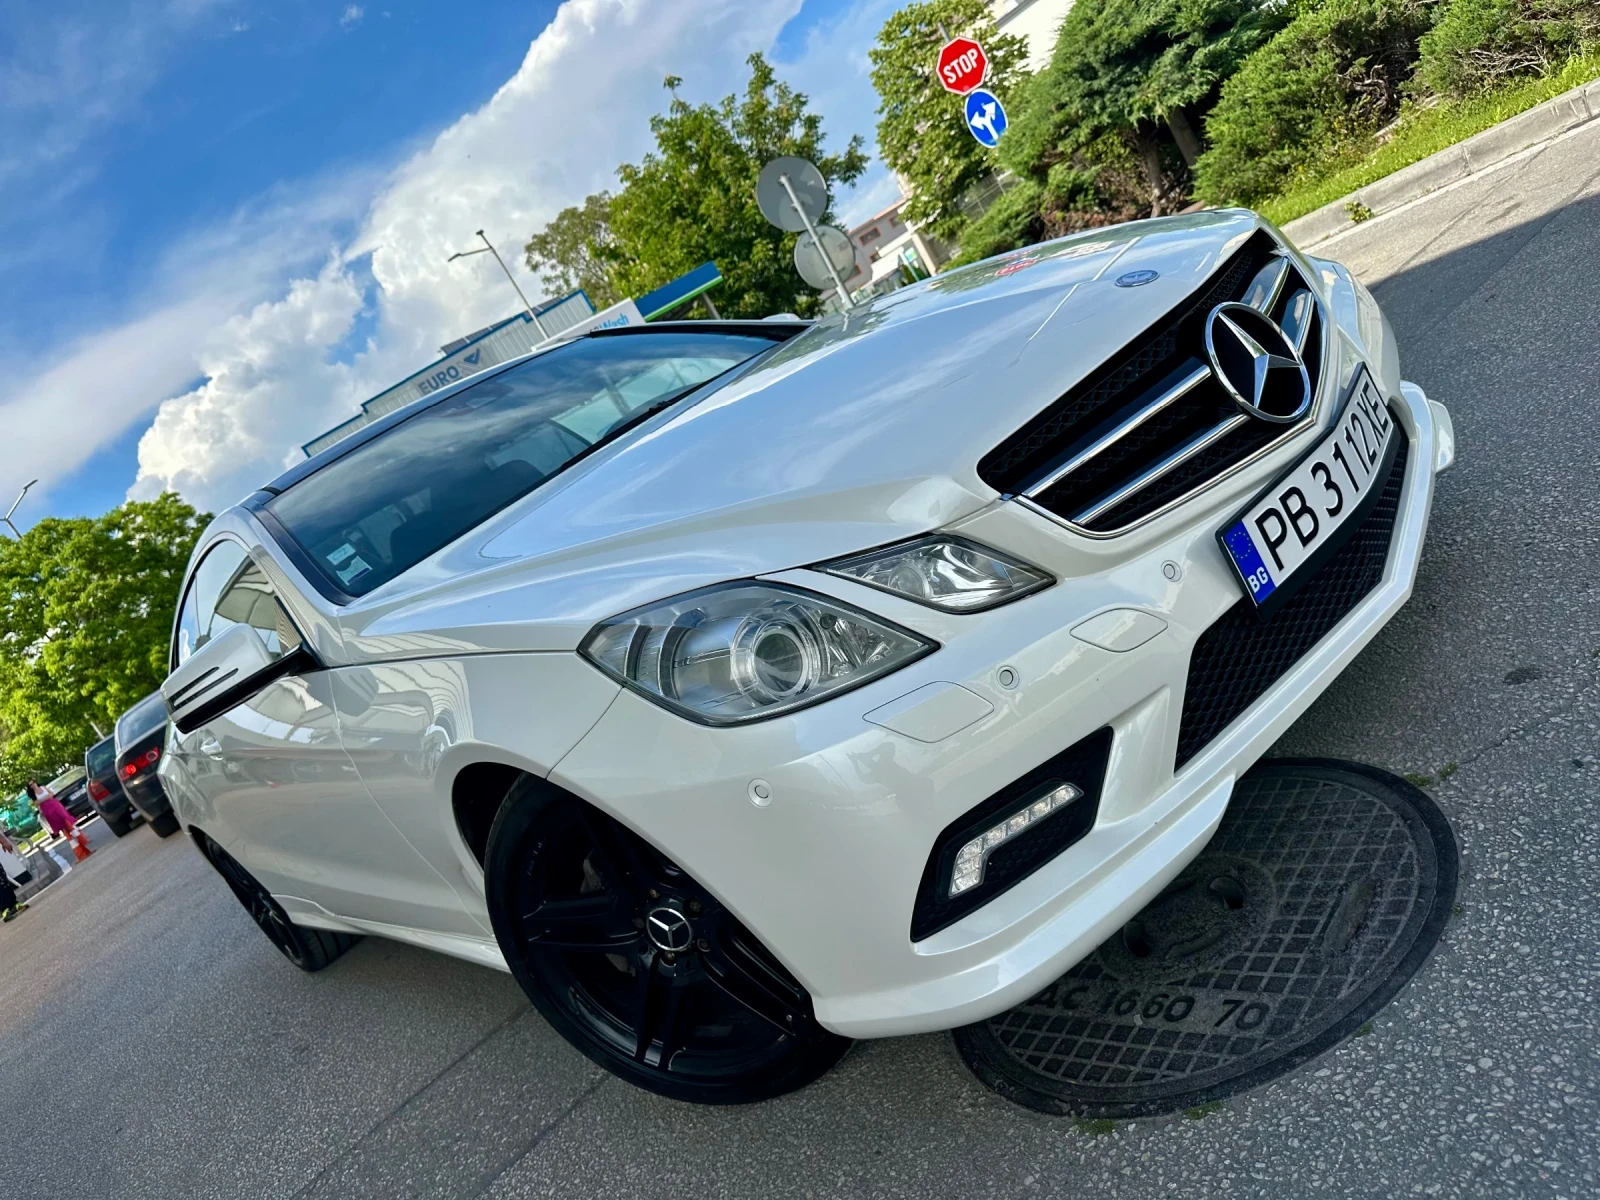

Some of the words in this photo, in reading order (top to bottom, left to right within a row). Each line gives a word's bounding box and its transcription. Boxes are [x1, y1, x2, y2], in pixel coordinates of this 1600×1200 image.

[943, 48, 978, 84] STOP
[418, 365, 460, 394] EURO
[1254, 486, 1320, 572] PB
[1247, 566, 1269, 594] BG
[1213, 999, 1271, 1031] 70
